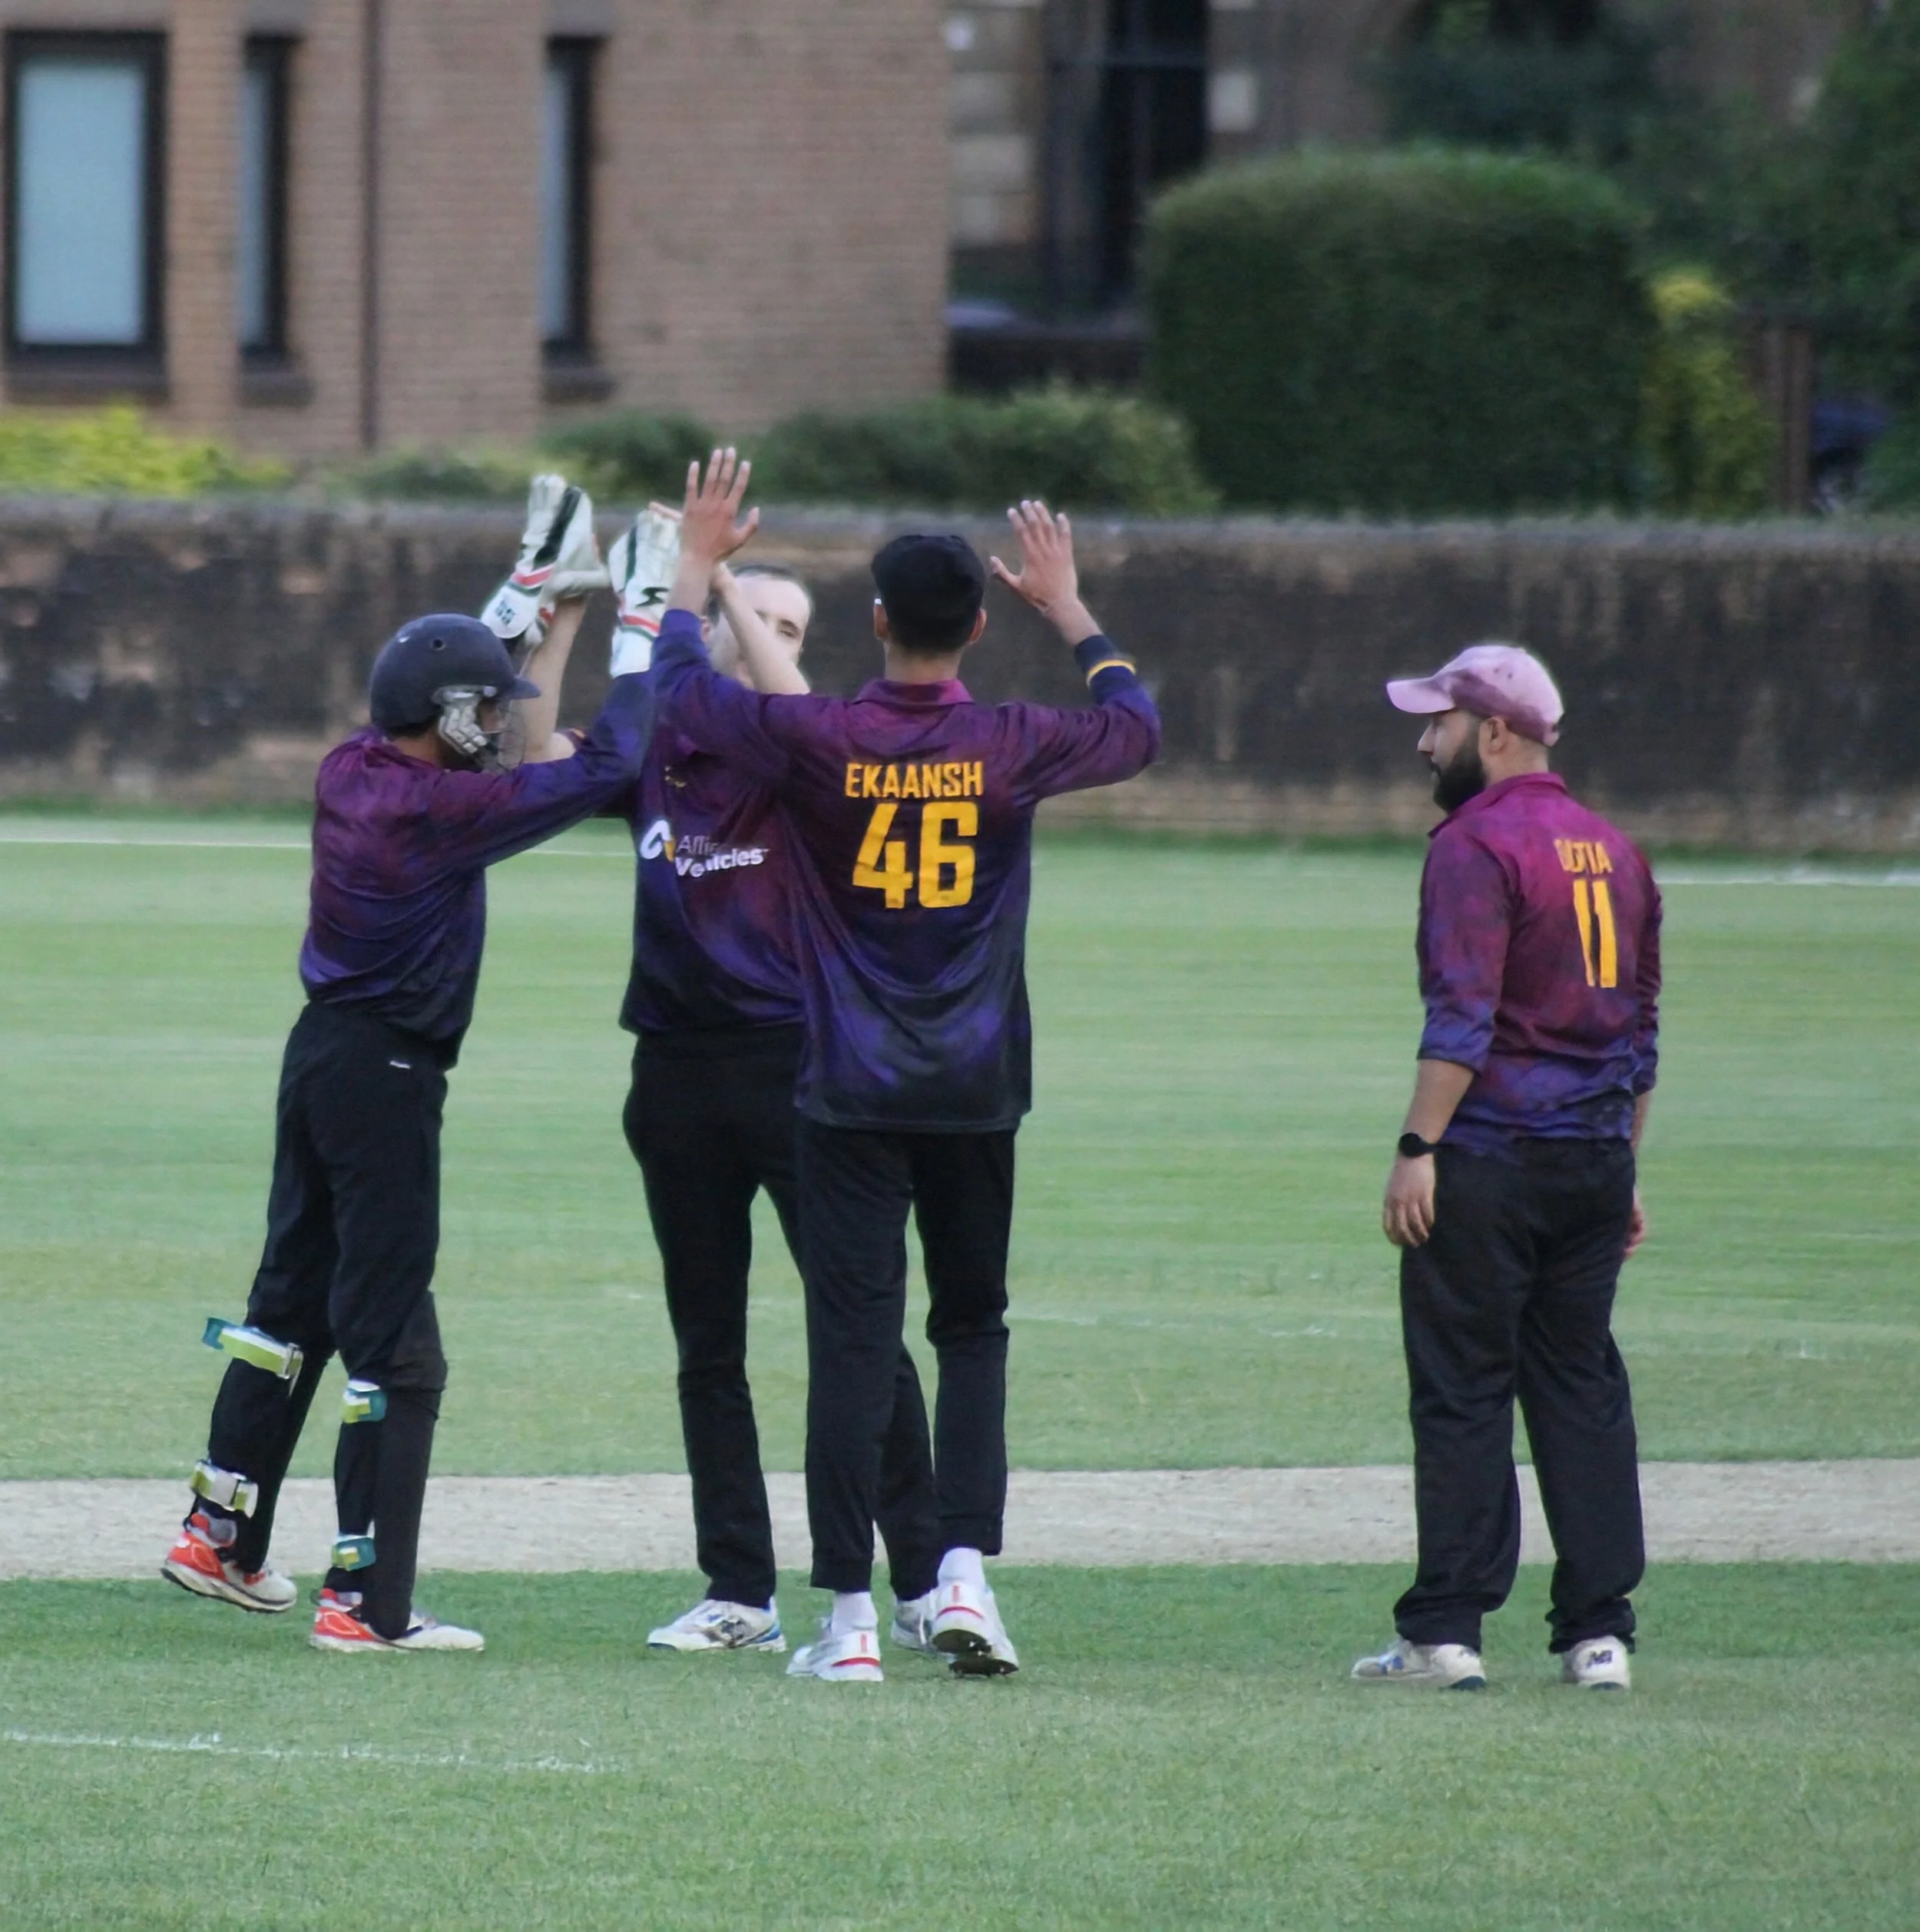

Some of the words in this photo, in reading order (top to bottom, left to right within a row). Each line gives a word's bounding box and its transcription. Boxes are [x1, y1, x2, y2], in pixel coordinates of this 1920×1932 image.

[845, 761, 984, 799] EKAANSH
[852, 800, 978, 909] 46
[1573, 877, 1617, 989] 11
